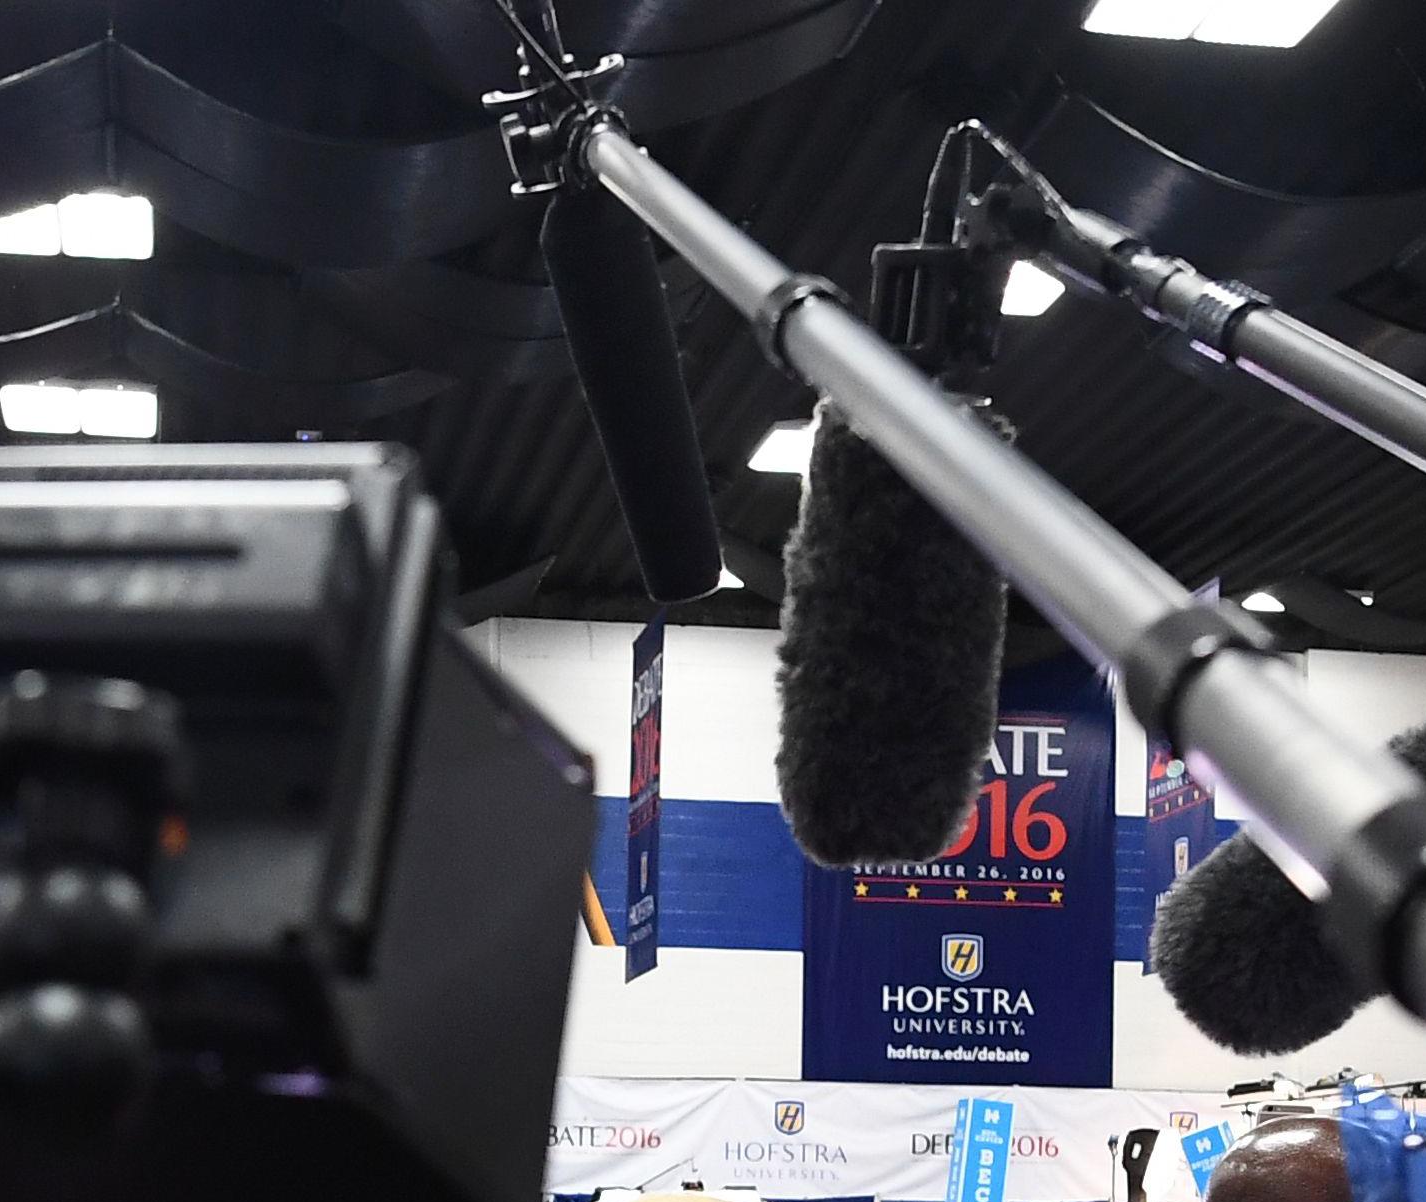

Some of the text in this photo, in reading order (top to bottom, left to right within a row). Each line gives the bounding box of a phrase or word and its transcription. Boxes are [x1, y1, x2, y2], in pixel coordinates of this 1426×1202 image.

[1020, 867, 1065, 880] 2016
[882, 985, 1035, 1015] HOFSTRA
[887, 1044, 1030, 1063] hofstra.edu/debate
[547, 1125, 662, 1148] BATE2016
[725, 1142, 848, 1163] HOFSTRA
